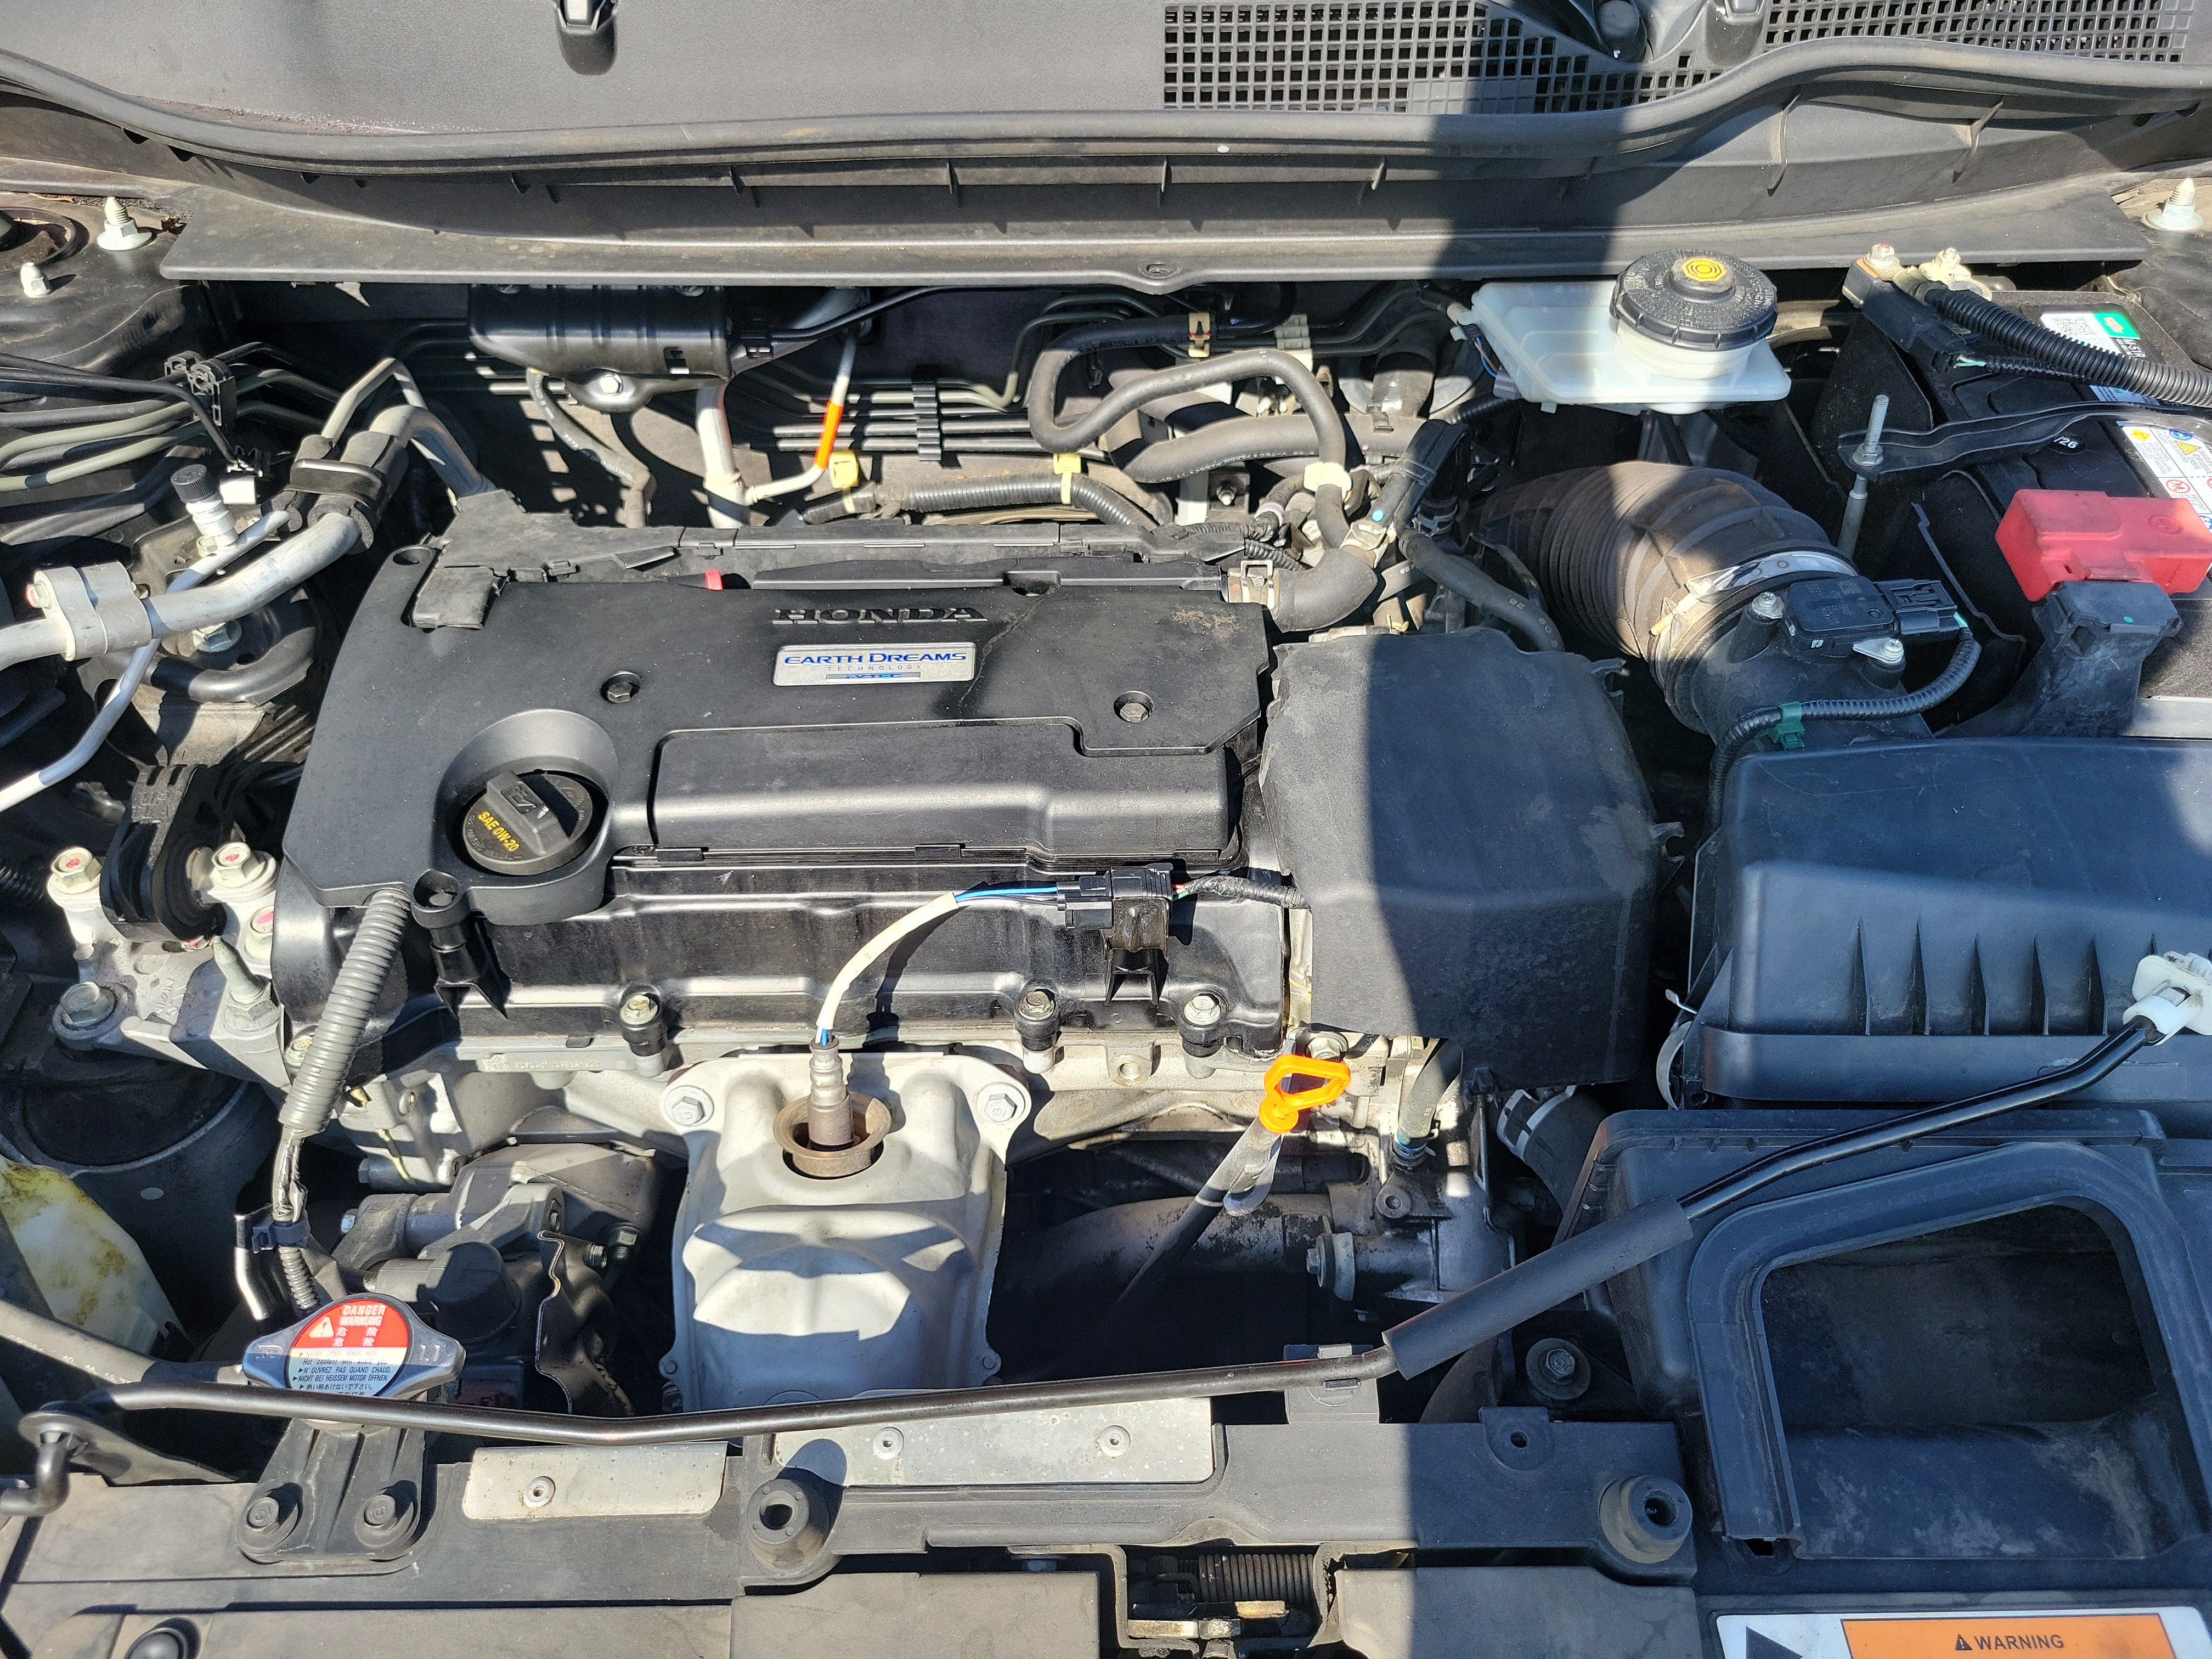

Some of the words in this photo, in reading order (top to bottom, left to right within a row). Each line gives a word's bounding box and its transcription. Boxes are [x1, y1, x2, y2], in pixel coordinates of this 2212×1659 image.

[772, 607, 988, 625] HONDA
[785, 655, 862, 665] EARTH
[869, 652, 968, 663] DREAMS
[477, 811, 500, 831] SAE
[492, 827, 521, 851] 0W-20
[342, 1305, 386, 1316] DANGER
[340, 1316, 383, 1327] WARNUNG
[368, 1373, 388, 1381] ÖFFNEN.
[1973, 1634, 2065, 1650] WARNING
